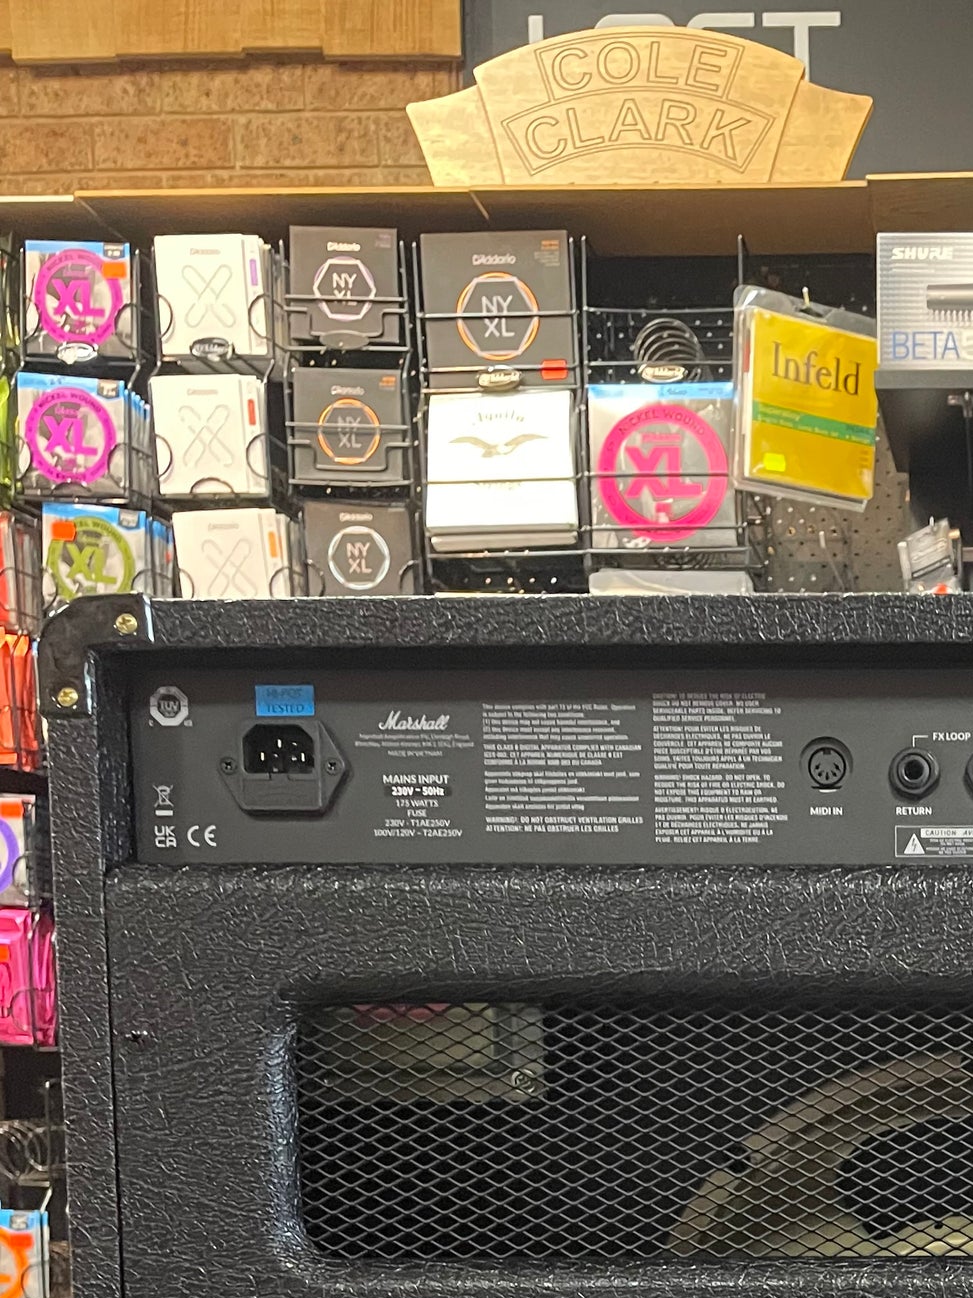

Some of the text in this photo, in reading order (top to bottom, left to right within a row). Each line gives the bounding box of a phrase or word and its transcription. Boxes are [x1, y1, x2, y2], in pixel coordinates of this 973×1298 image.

[551, 40, 734, 93] COLE
[524, 97, 752, 161] CLARK
[890, 247, 953, 261] SHURE
[332, 272, 357, 289] NY
[52, 278, 106, 318] XL
[481, 296, 514, 314] NY
[484, 318, 516, 338] XL
[771, 340, 861, 396] Infeld
[618, 408, 706, 437] NICKEL WOUND
[42, 415, 99, 457] XL
[338, 433, 362, 449] XL
[622, 445, 703, 499] XL
[346, 542, 370, 559] NY
[65, 542, 118, 584] XL
[349, 558, 373, 574] XL
[267, 703, 305, 713] TESTED
[378, 710, 450, 731] Marshall
[932, 732, 971, 742] FX LOOP
[382, 774, 449, 784] MAINS INPUT
[391, 786, 445, 796] 230V 50Hz
[410, 799, 439, 808] WATTS
[809, 806, 843, 816] MIDI IN
[895, 806, 932, 815] RETURN
[407, 809, 427, 818] FUSE
[530, 816, 544, 824] NOT
[545, 816, 577, 824] OBSTRUCT
[578, 816, 616, 824] VENTILATION
[154, 825, 176, 837] UK
[187, 824, 217, 848] CE
[925, 829, 957, 837] CAUTION
[154, 837, 177, 848] CA
